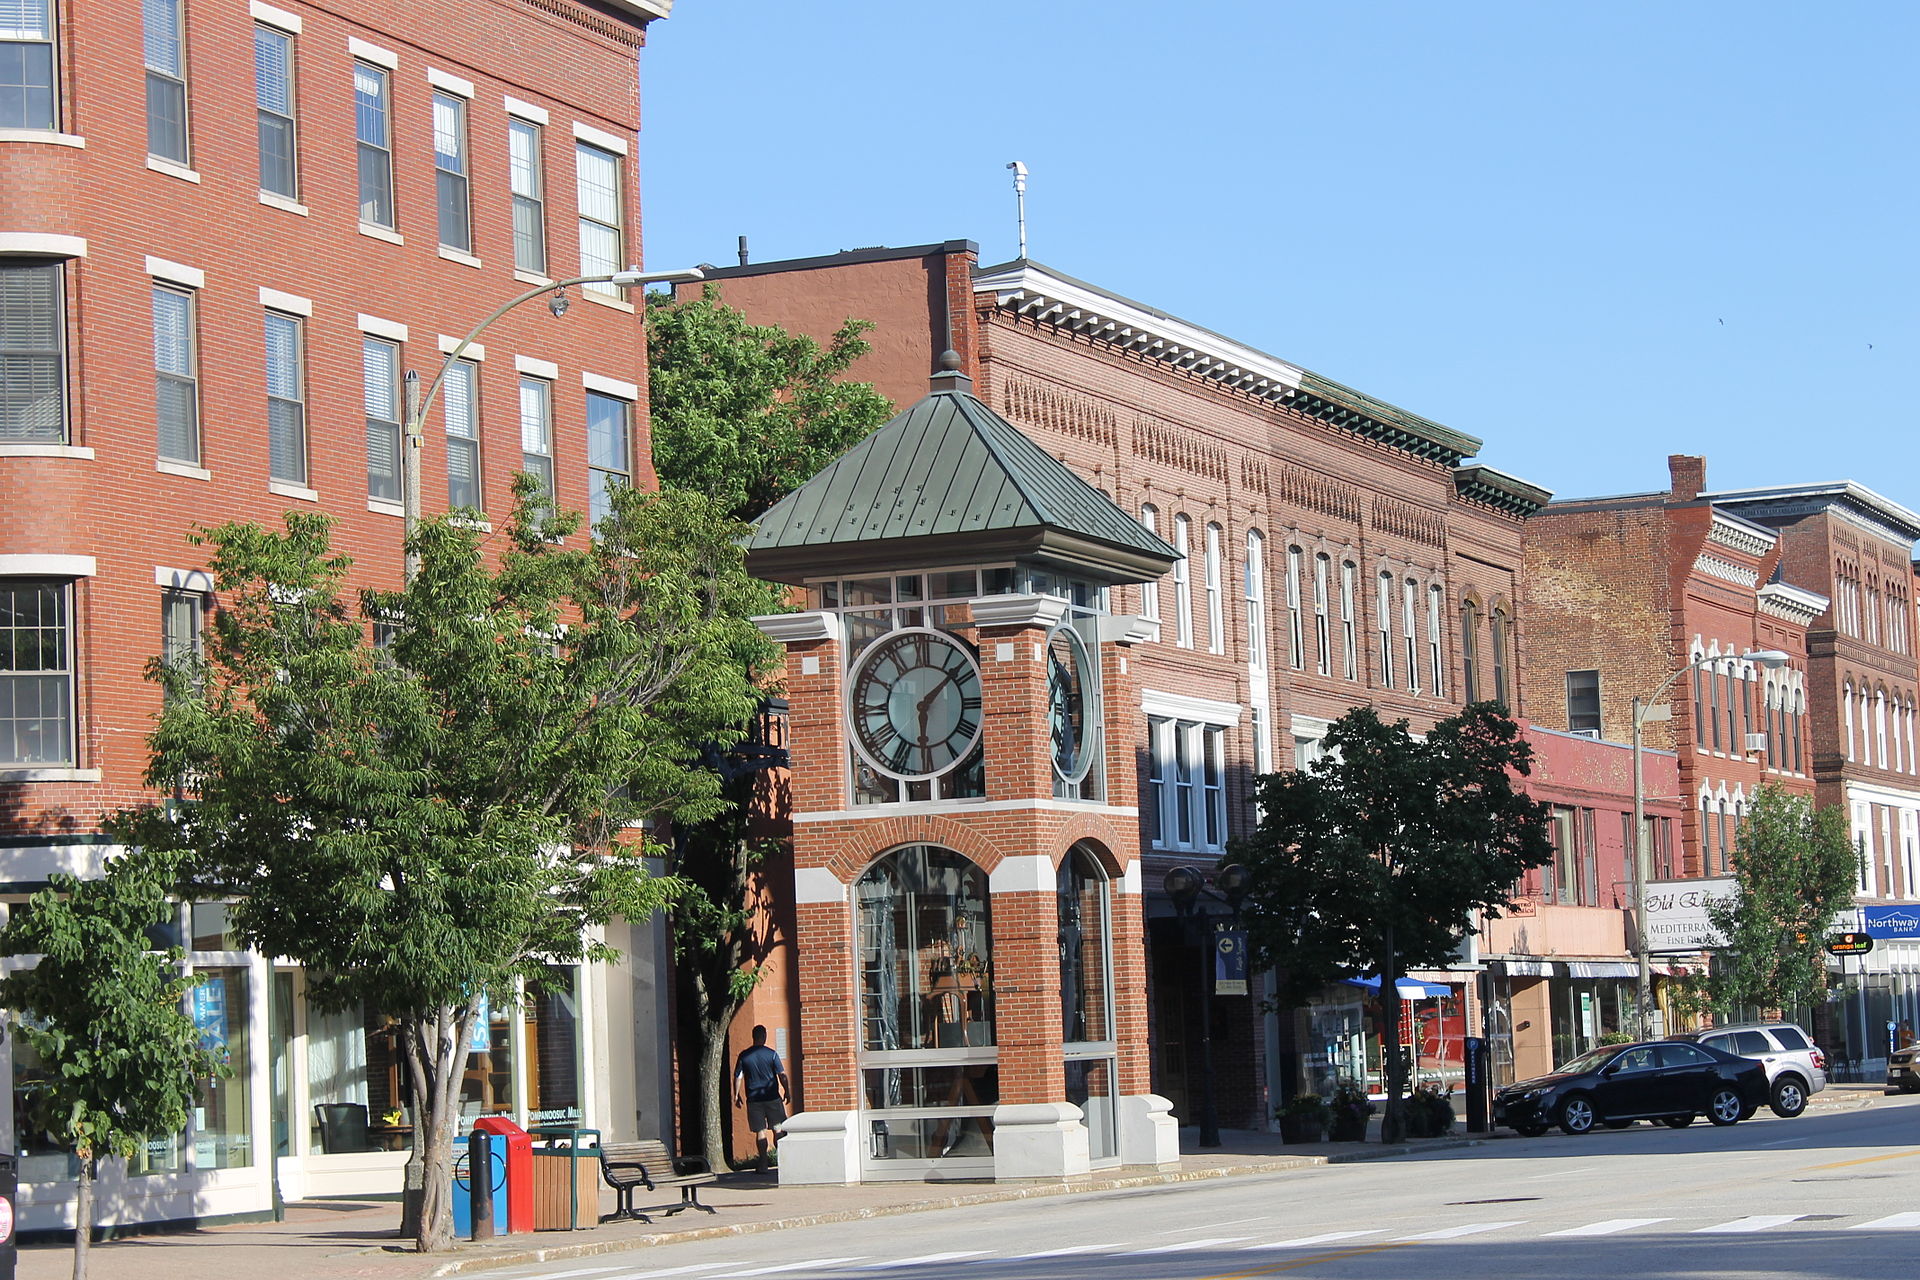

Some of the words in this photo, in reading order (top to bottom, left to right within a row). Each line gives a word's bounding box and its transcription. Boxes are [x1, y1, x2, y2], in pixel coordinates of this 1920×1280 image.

[1646, 893, 1675, 913] Old
[1650, 922, 1715, 935] MEDITERRAN
[1868, 917, 1919, 929] Northway
[1667, 936, 1685, 944] FINE
[199, 988, 207, 1030] UMMER
[527, 1109, 566, 1121] POMPANOOSUC
